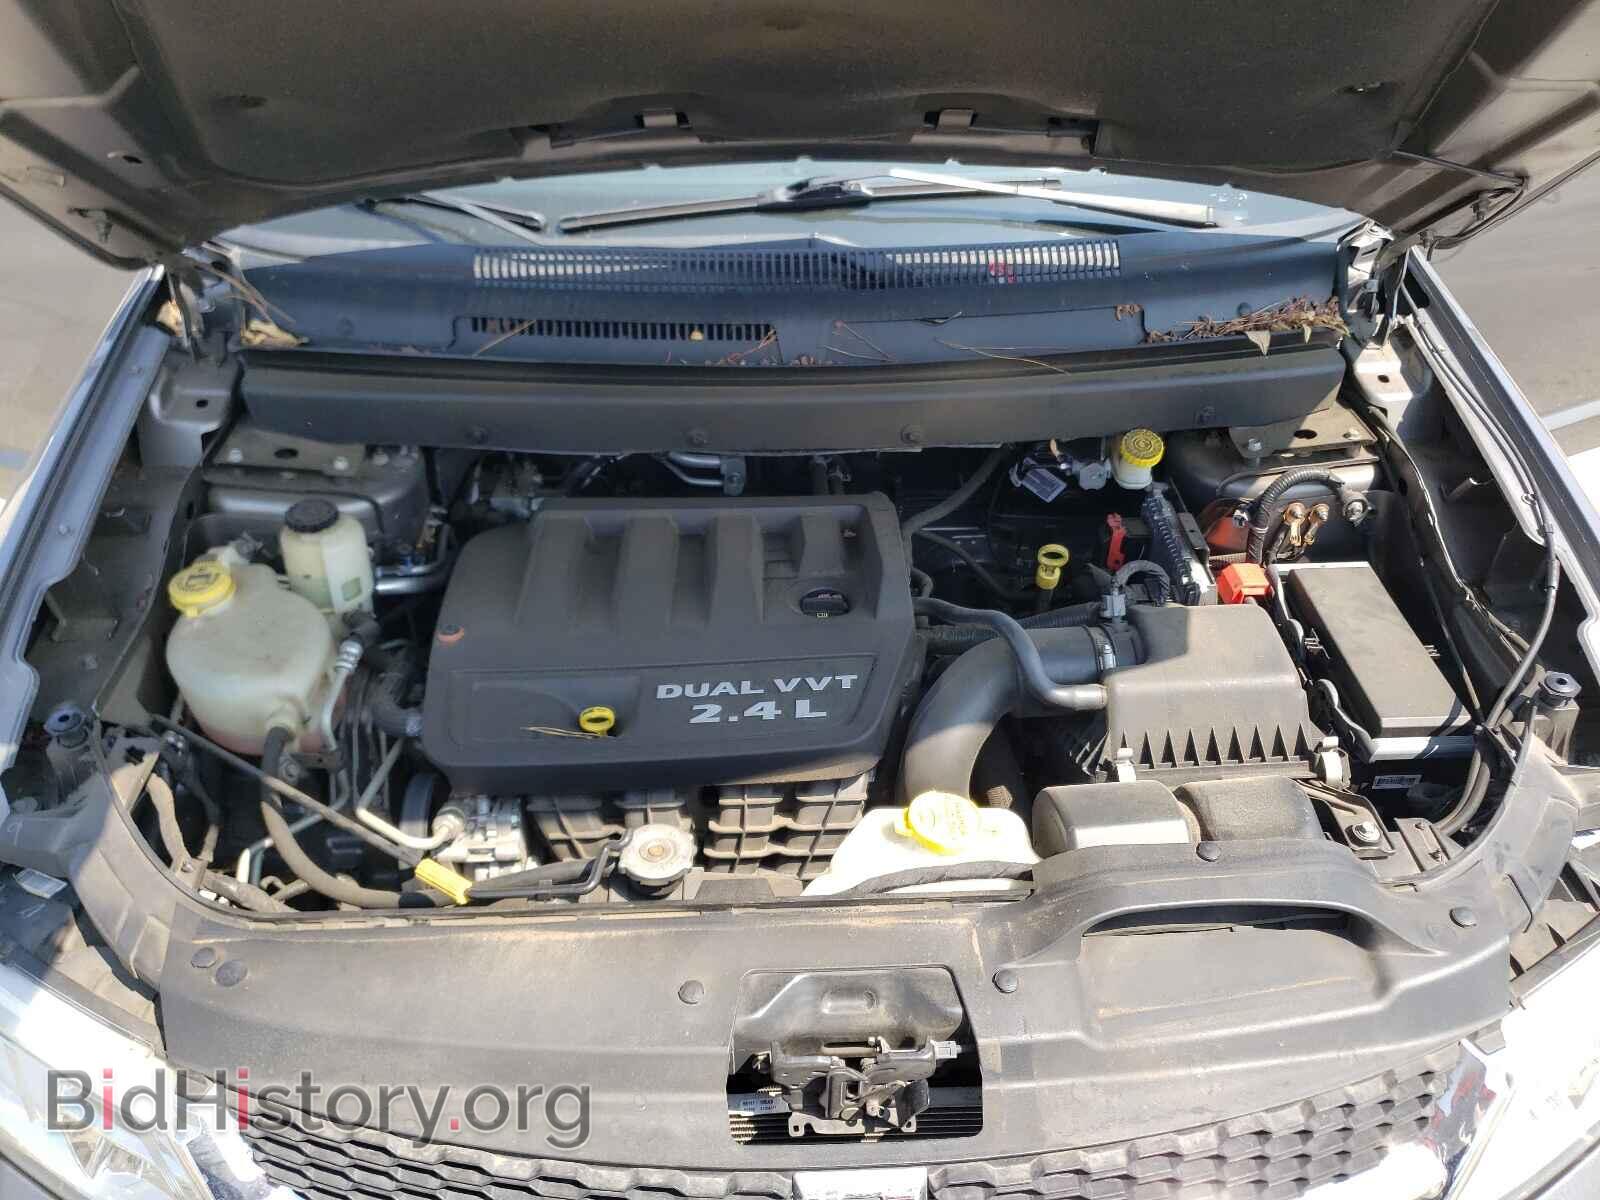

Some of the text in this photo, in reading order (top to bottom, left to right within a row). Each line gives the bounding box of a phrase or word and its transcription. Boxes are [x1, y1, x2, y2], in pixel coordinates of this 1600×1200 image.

[656, 674, 858, 699] DUAL VVT
[688, 699, 827, 724] 2.4 L
